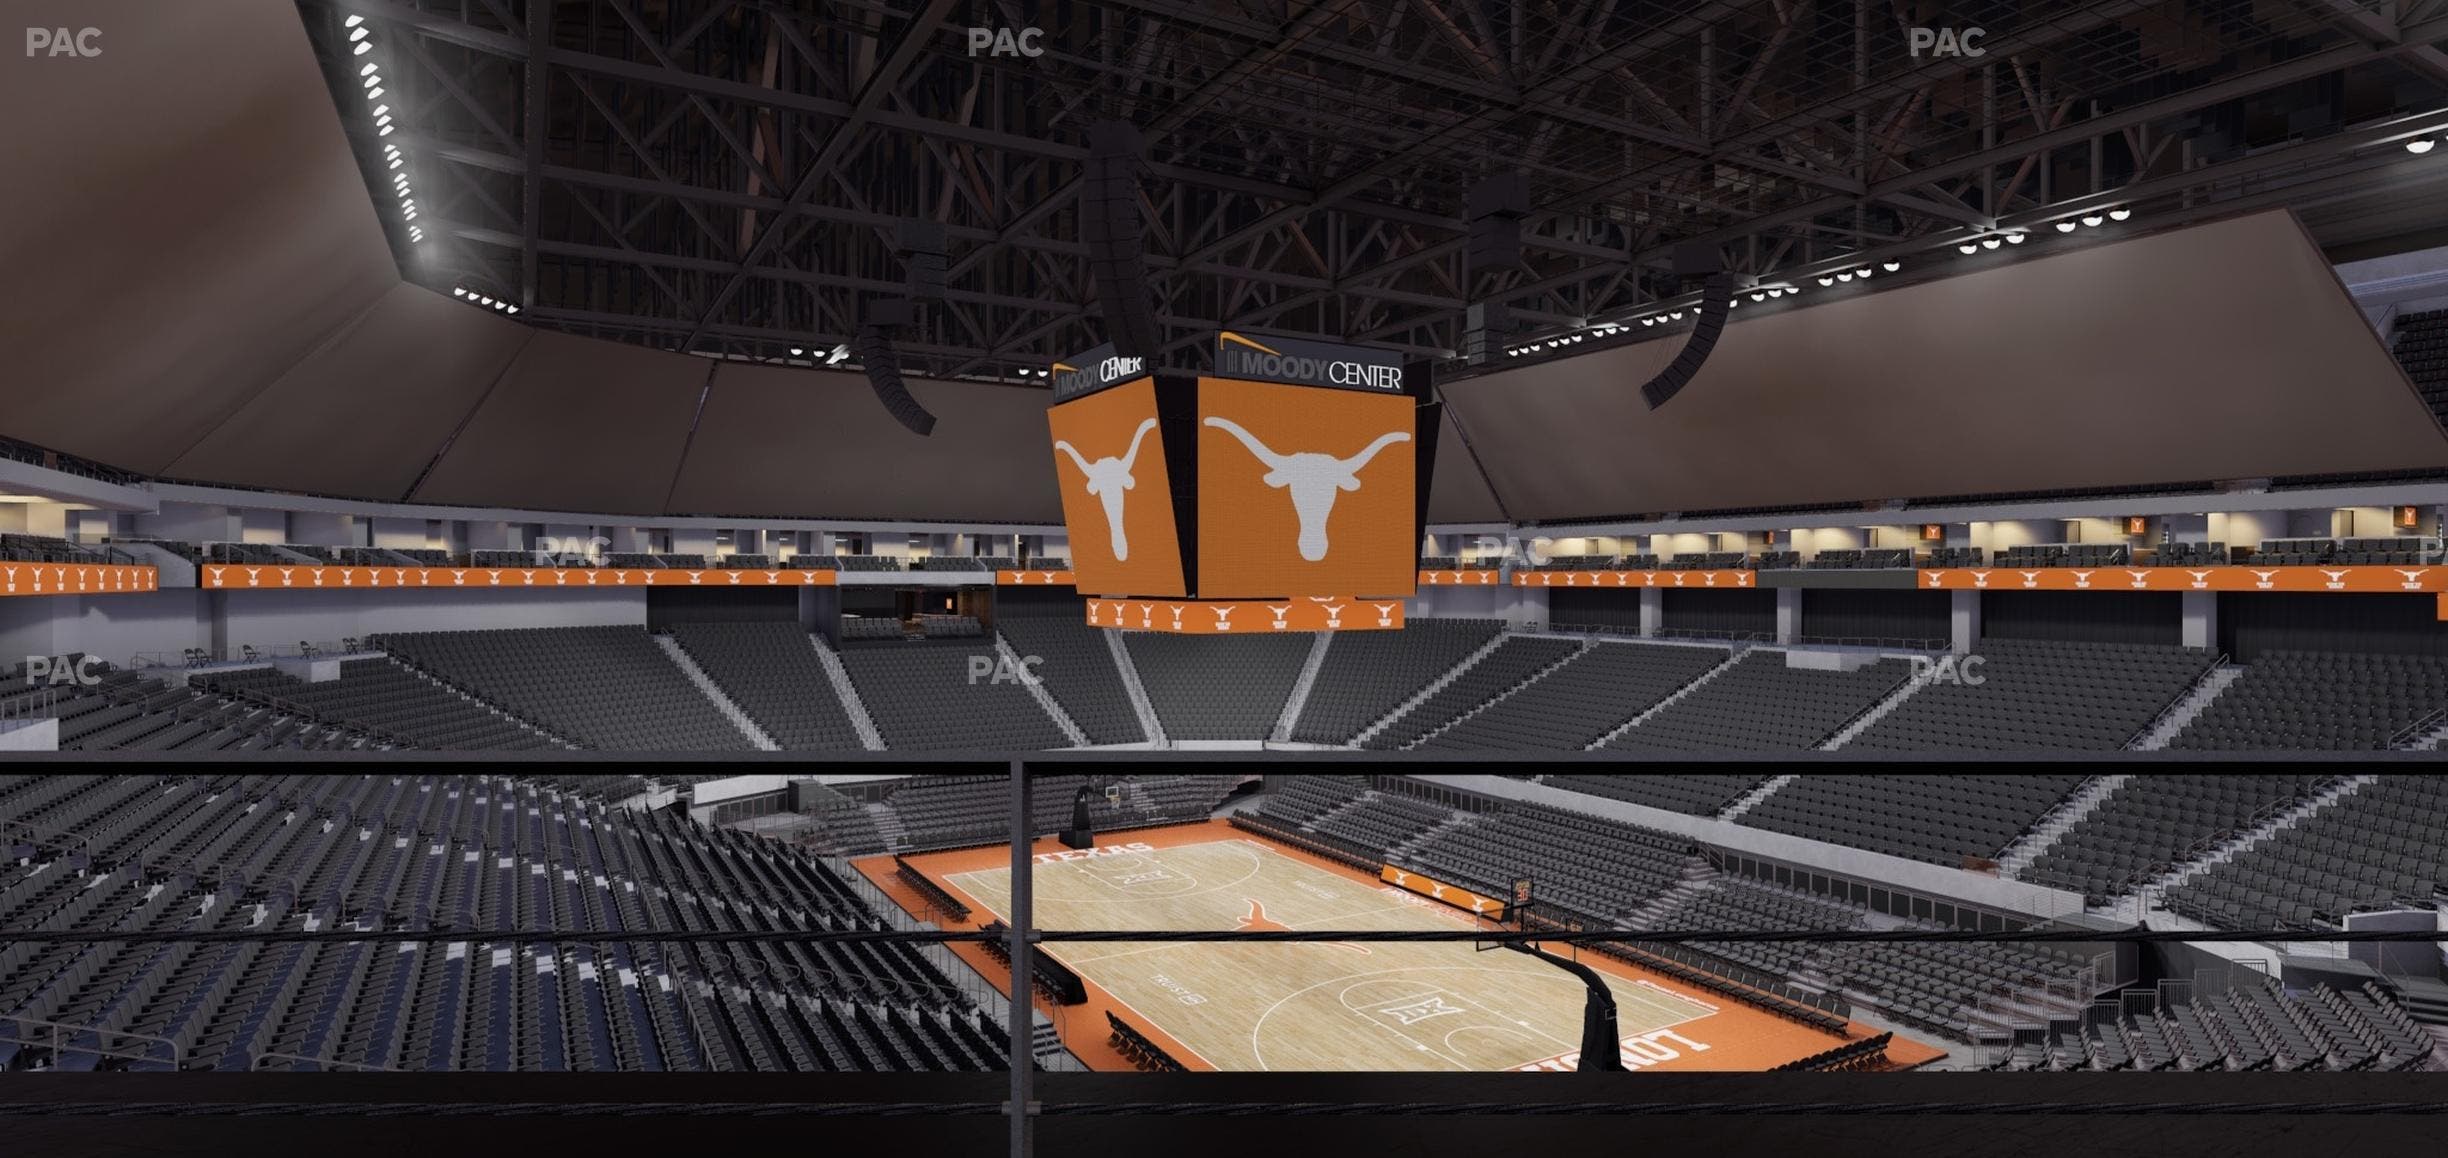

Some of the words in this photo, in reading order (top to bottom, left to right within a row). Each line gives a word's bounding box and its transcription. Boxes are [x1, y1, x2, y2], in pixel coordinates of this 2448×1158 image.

[1061, 363, 1099, 396] MOODY
[1242, 351, 1328, 381] MOODY
[1329, 361, 1402, 390] CENTER
[1032, 842, 1153, 864] TEXAS
